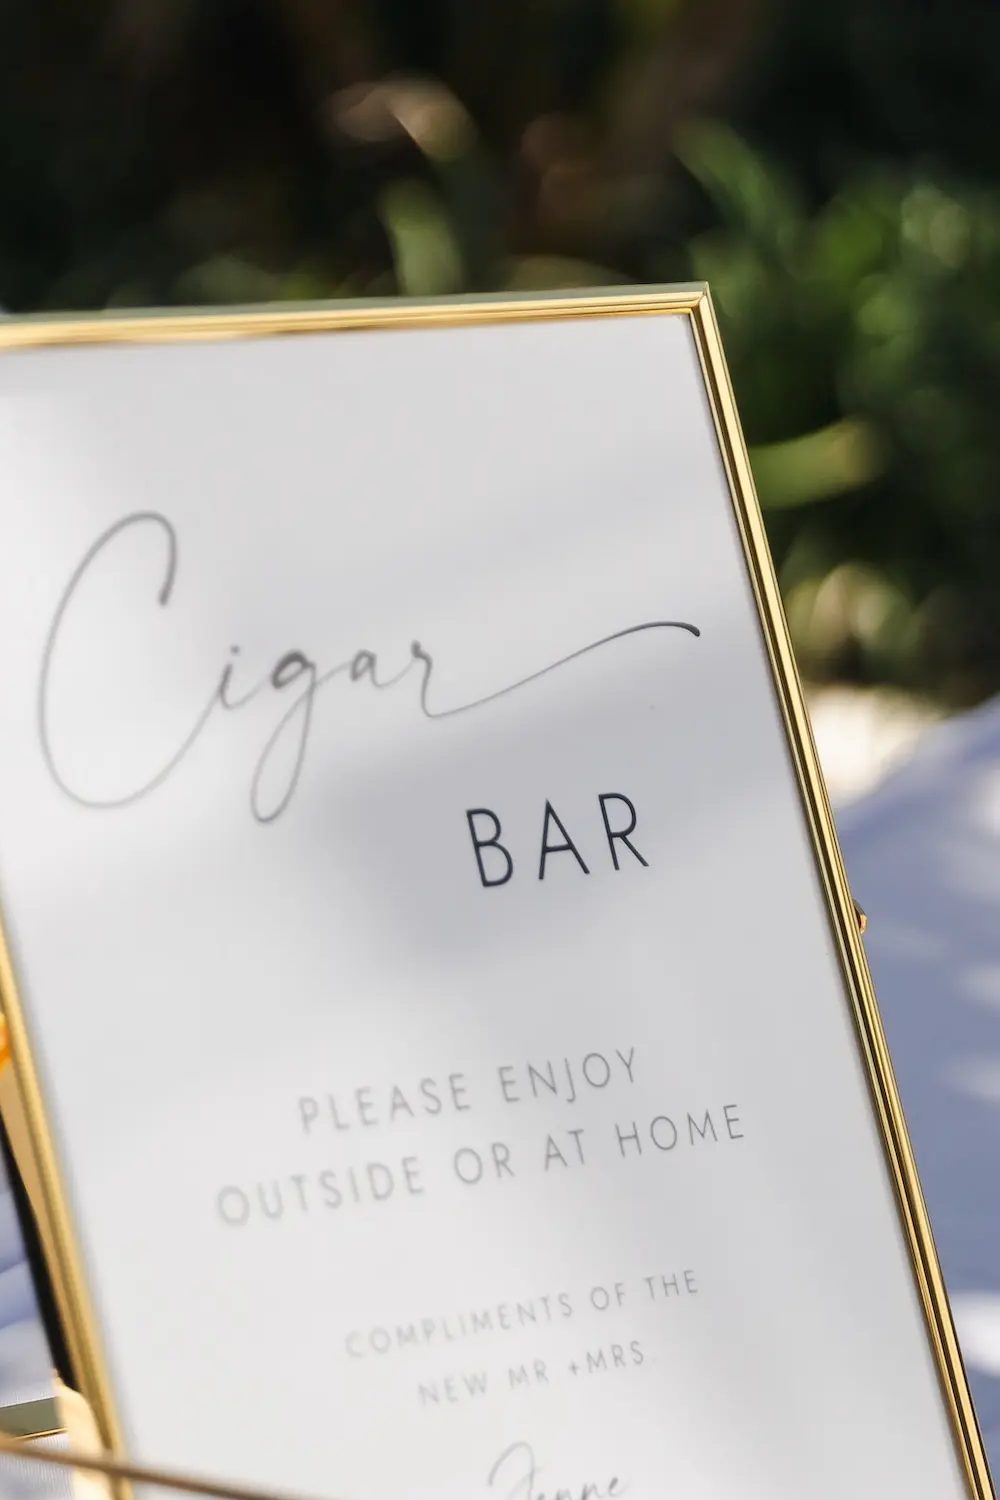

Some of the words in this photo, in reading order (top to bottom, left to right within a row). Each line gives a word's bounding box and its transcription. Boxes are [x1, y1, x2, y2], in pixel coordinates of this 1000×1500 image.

[38, 510, 701, 824] Cigar
[465, 792, 649, 888] BAR
[298, 1072, 471, 1135] PLEASE
[498, 1047, 636, 1103] ENJOY
[216, 1156, 425, 1227] OUTSIDE
[453, 1142, 515, 1184] OR
[543, 1129, 585, 1171] AT
[615, 1104, 744, 1158] HOME
[345, 1292, 573, 1359] COMPLIMENTS
[589, 1282, 626, 1311] OF
[643, 1269, 699, 1301] THE
[418, 1371, 488, 1407] NEW
[508, 1359, 549, 1390] MR
